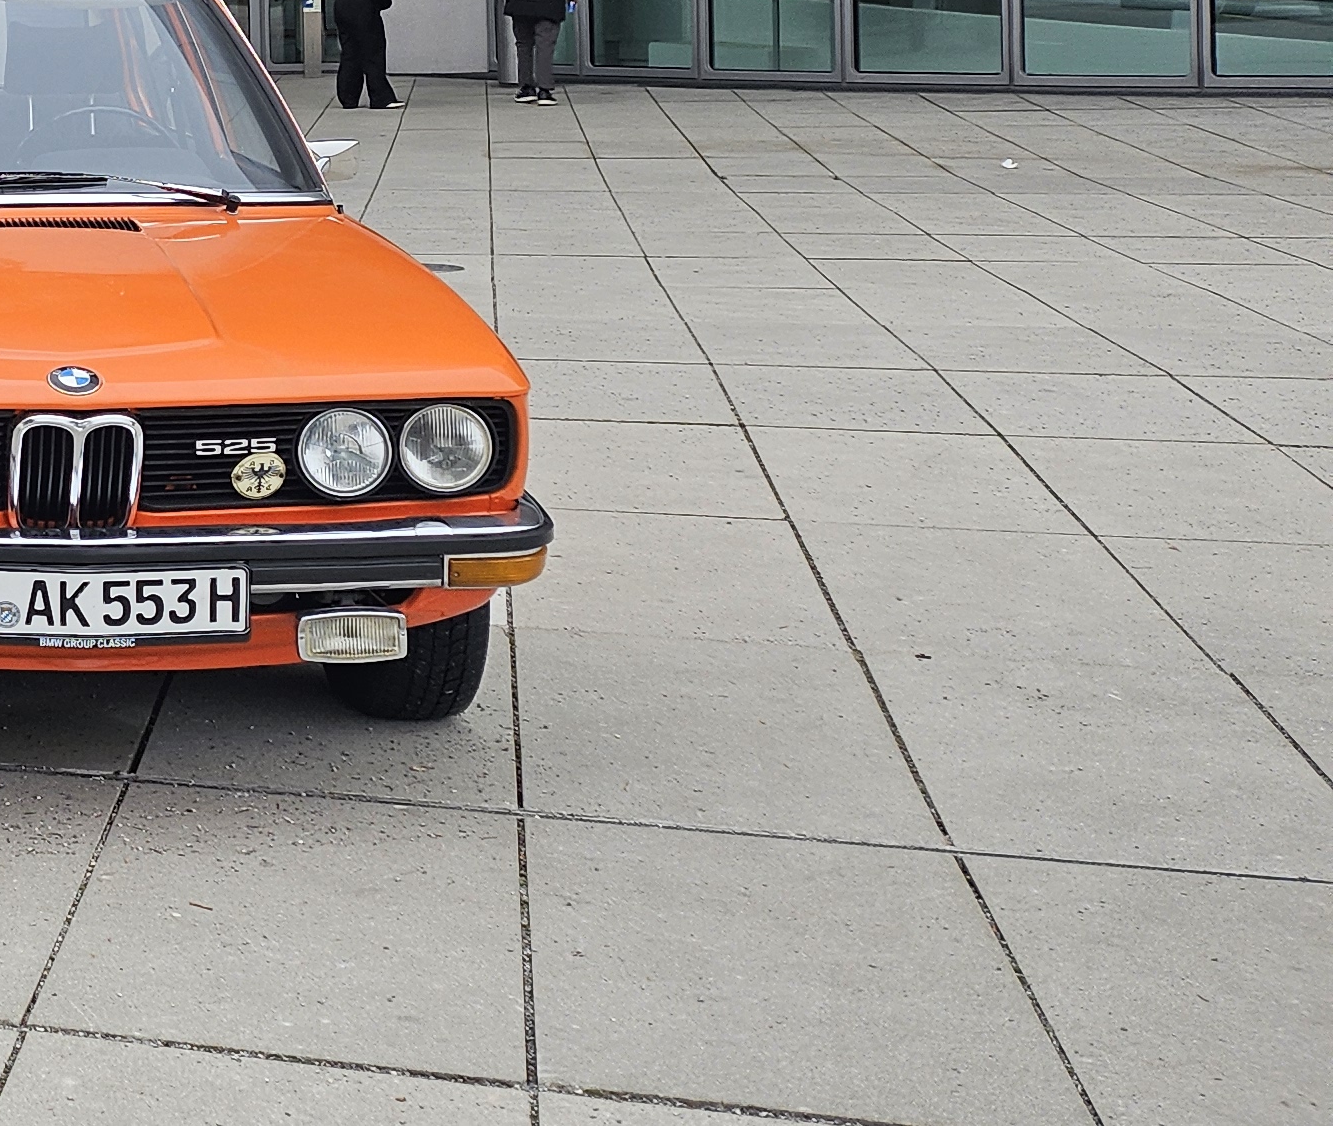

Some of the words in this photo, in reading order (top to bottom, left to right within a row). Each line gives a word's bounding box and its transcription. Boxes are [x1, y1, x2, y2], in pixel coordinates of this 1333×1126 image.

[195, 437, 277, 456] 525
[25, 579, 90, 628] AK
[39, 637, 62, 647] BMW
[63, 638, 96, 649] GROUP
[97, 638, 136, 648] CLASSIC
